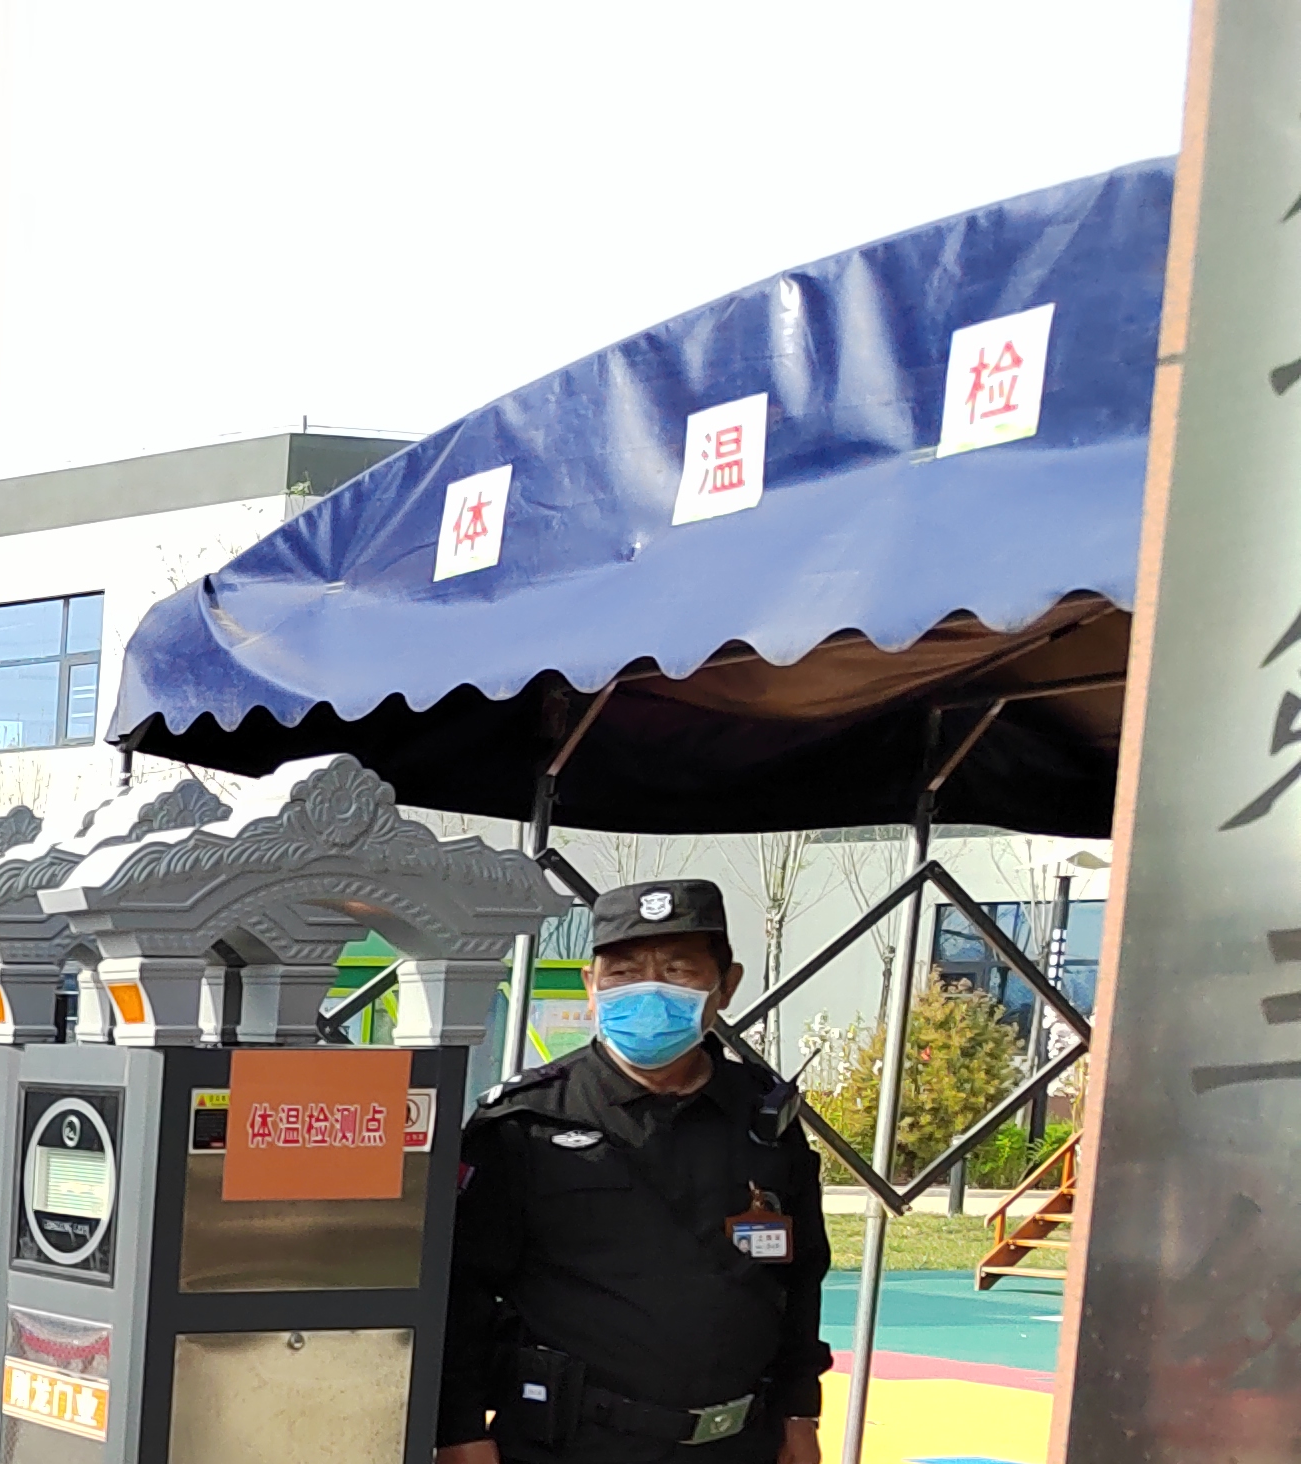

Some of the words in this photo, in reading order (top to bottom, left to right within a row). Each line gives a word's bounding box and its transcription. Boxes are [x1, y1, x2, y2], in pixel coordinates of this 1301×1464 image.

[248, 1102, 387, 1149] 体温检测点
